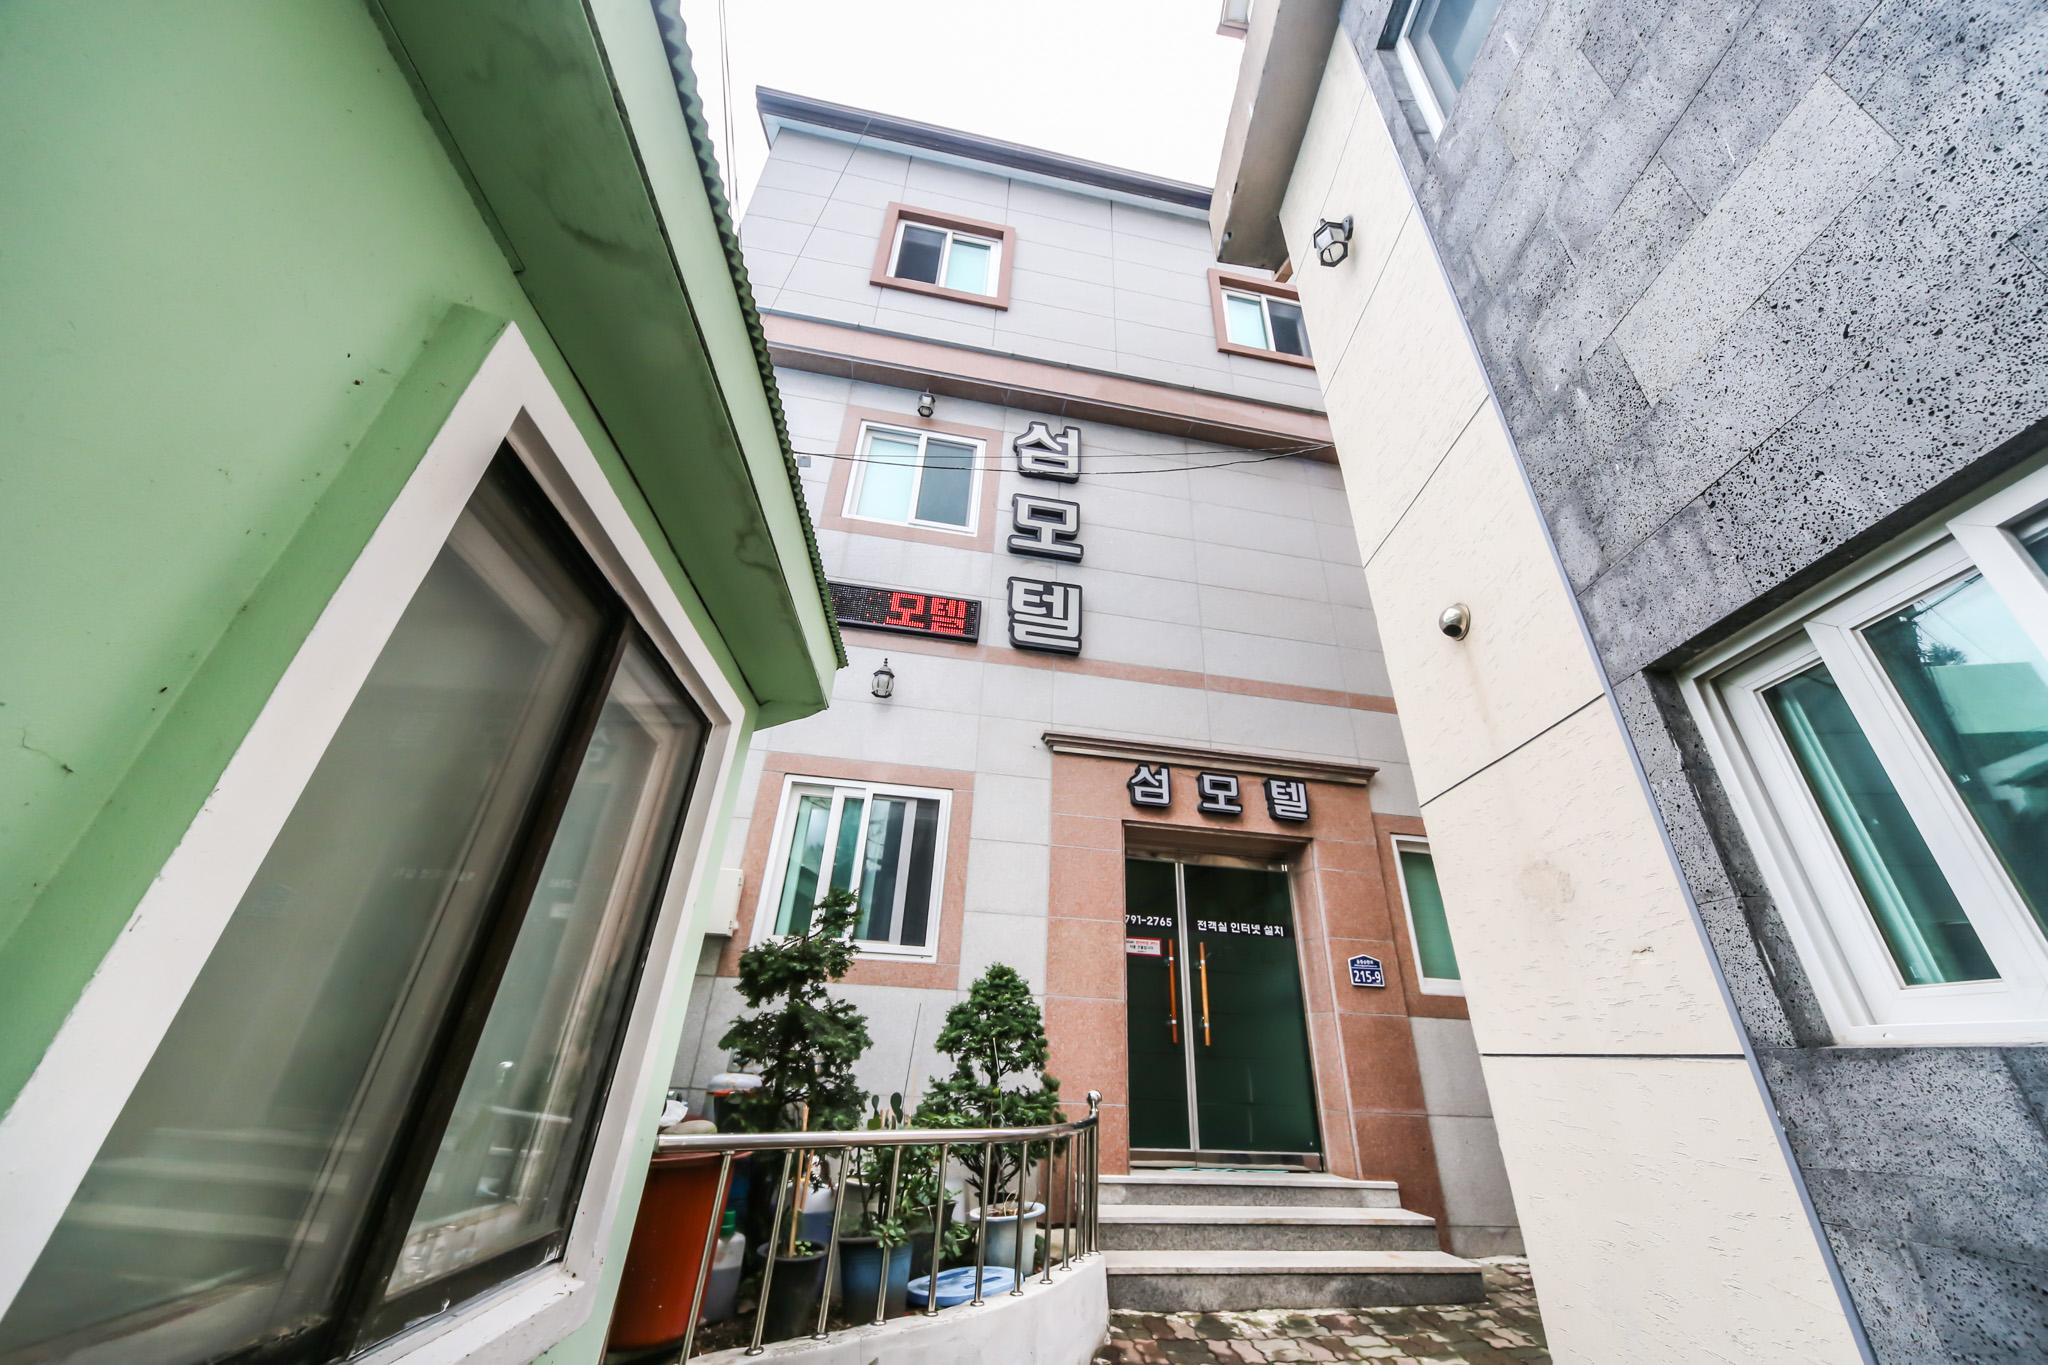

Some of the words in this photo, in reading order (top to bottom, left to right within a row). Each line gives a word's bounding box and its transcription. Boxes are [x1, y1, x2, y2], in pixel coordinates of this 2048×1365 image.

[886, 592, 966, 634] 모텔
[1125, 914, 1172, 927] 791-2765
[1197, 920, 1227, 932] 전객실
[1230, 922, 1261, 935] 인터넷
[1263, 925, 1284, 937] 설치
[1353, 970, 1381, 983] 215-9
